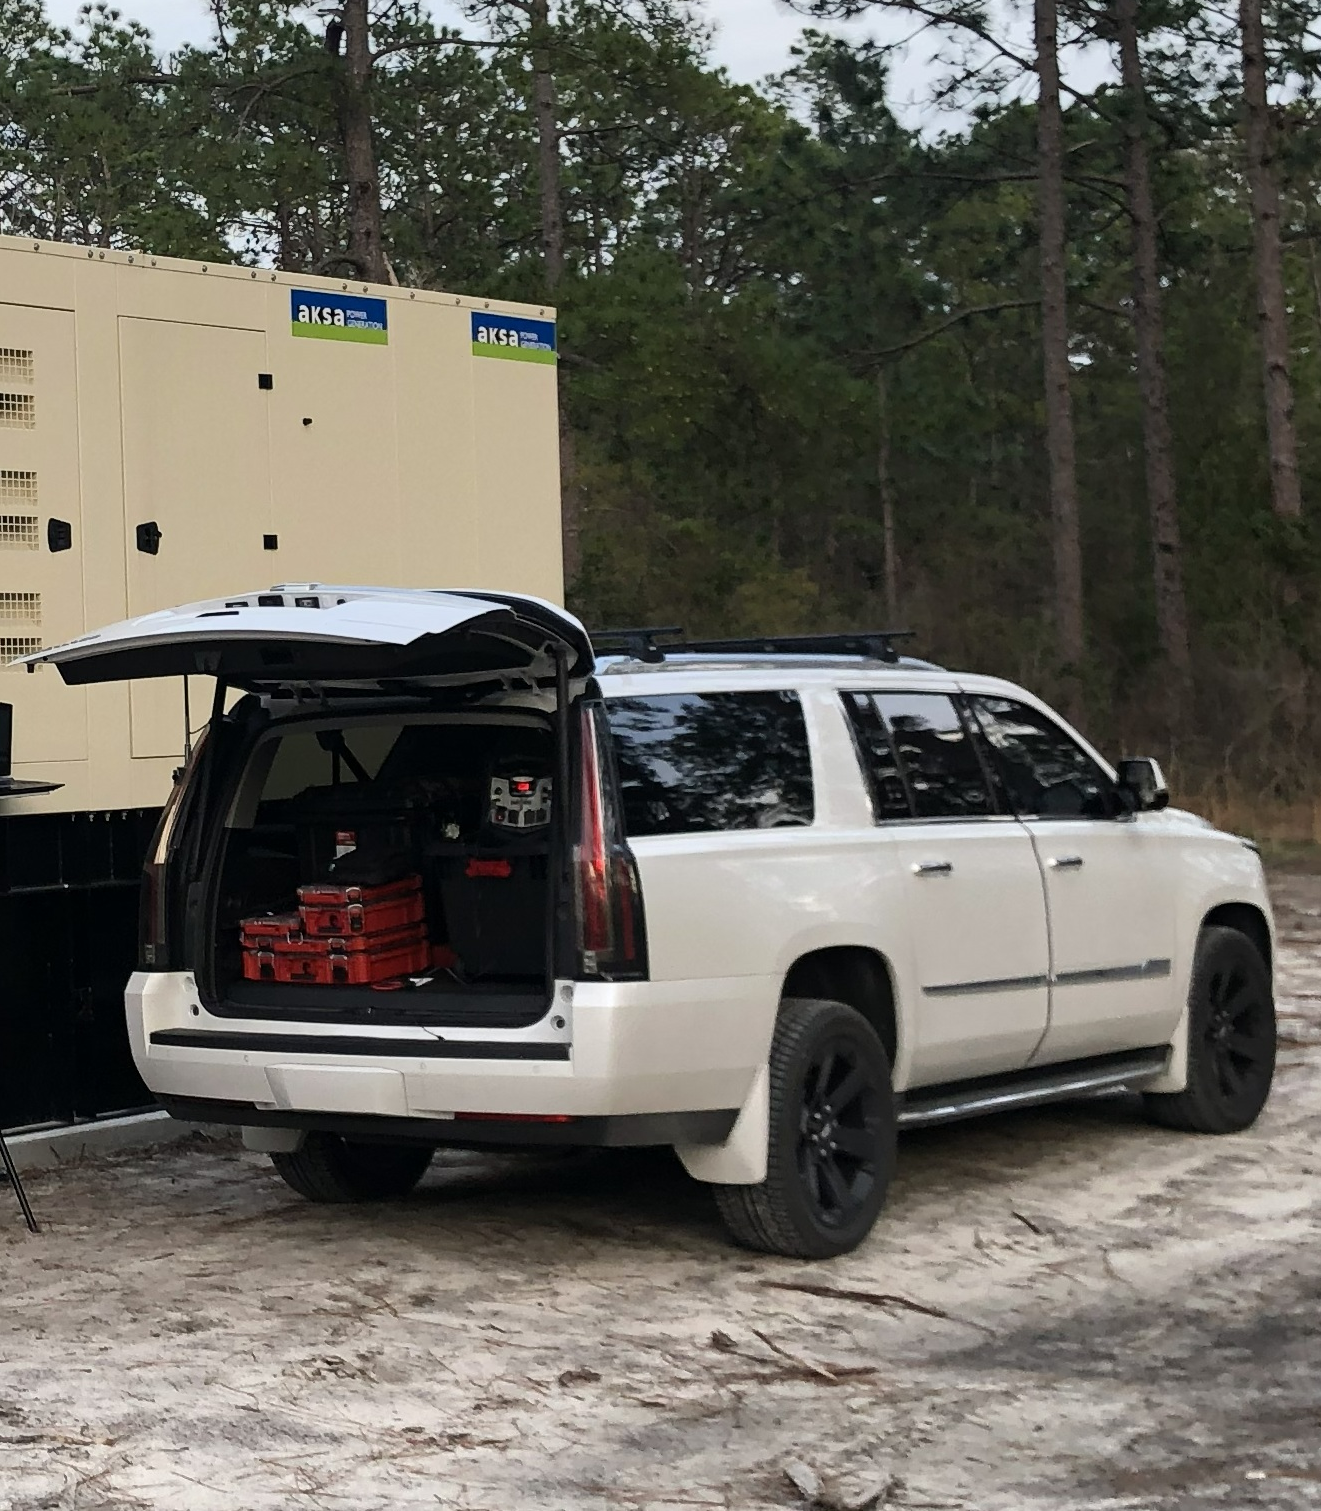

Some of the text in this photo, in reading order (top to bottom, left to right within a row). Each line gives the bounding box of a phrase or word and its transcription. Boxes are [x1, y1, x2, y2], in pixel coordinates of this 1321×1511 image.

[298, 304, 345, 327] aksa
[346, 309, 367, 320] POWER
[346, 319, 384, 331] GENERATION
[477, 325, 519, 348] aksa
